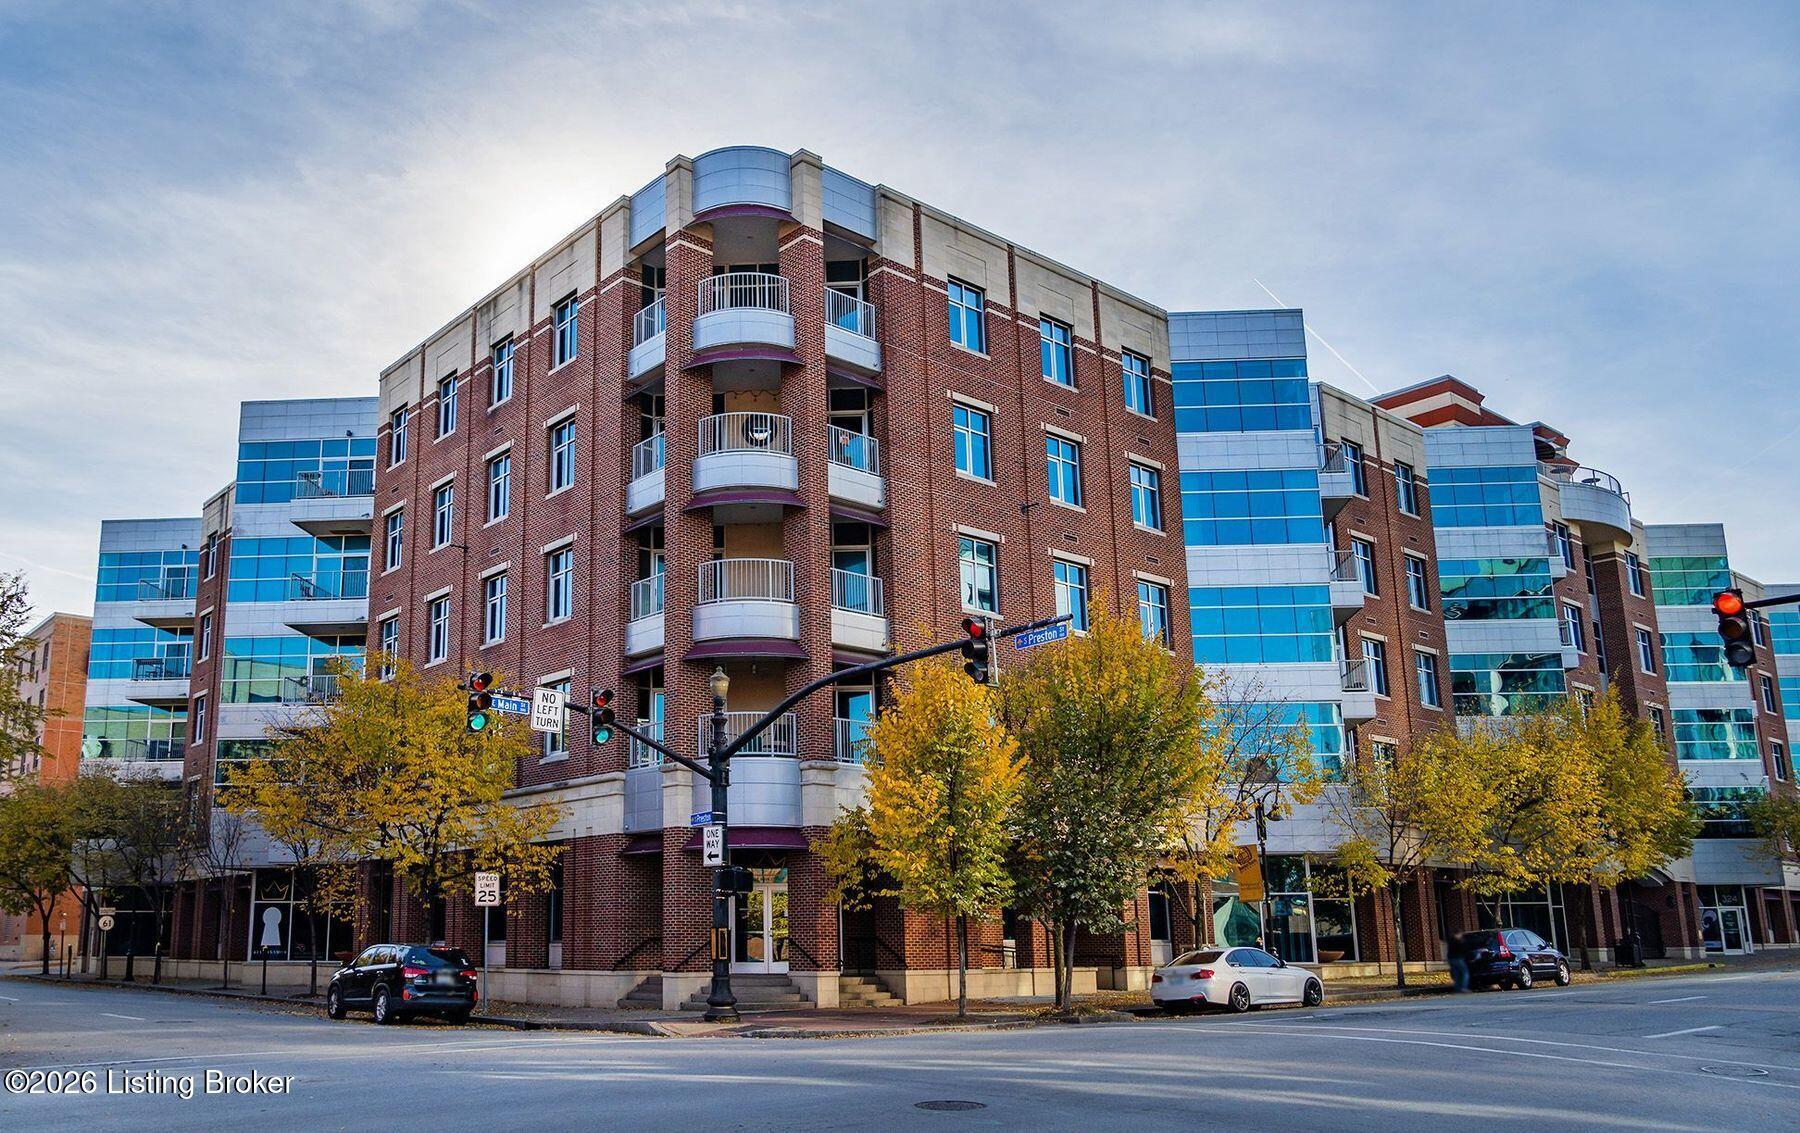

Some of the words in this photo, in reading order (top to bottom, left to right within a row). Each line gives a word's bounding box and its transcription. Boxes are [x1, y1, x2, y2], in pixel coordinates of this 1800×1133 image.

[1028, 630, 1058, 645] Preston
[541, 692, 556, 705] NO
[497, 699, 518, 711] Main
[536, 704, 559, 716] LEFT
[535, 716, 559, 728] TURN
[706, 828, 720, 838] ONE
[706, 839, 720, 849] WAY
[477, 890, 497, 903] 25
[1721, 894, 1738, 903] 324
[102, 919, 112, 928] 61
